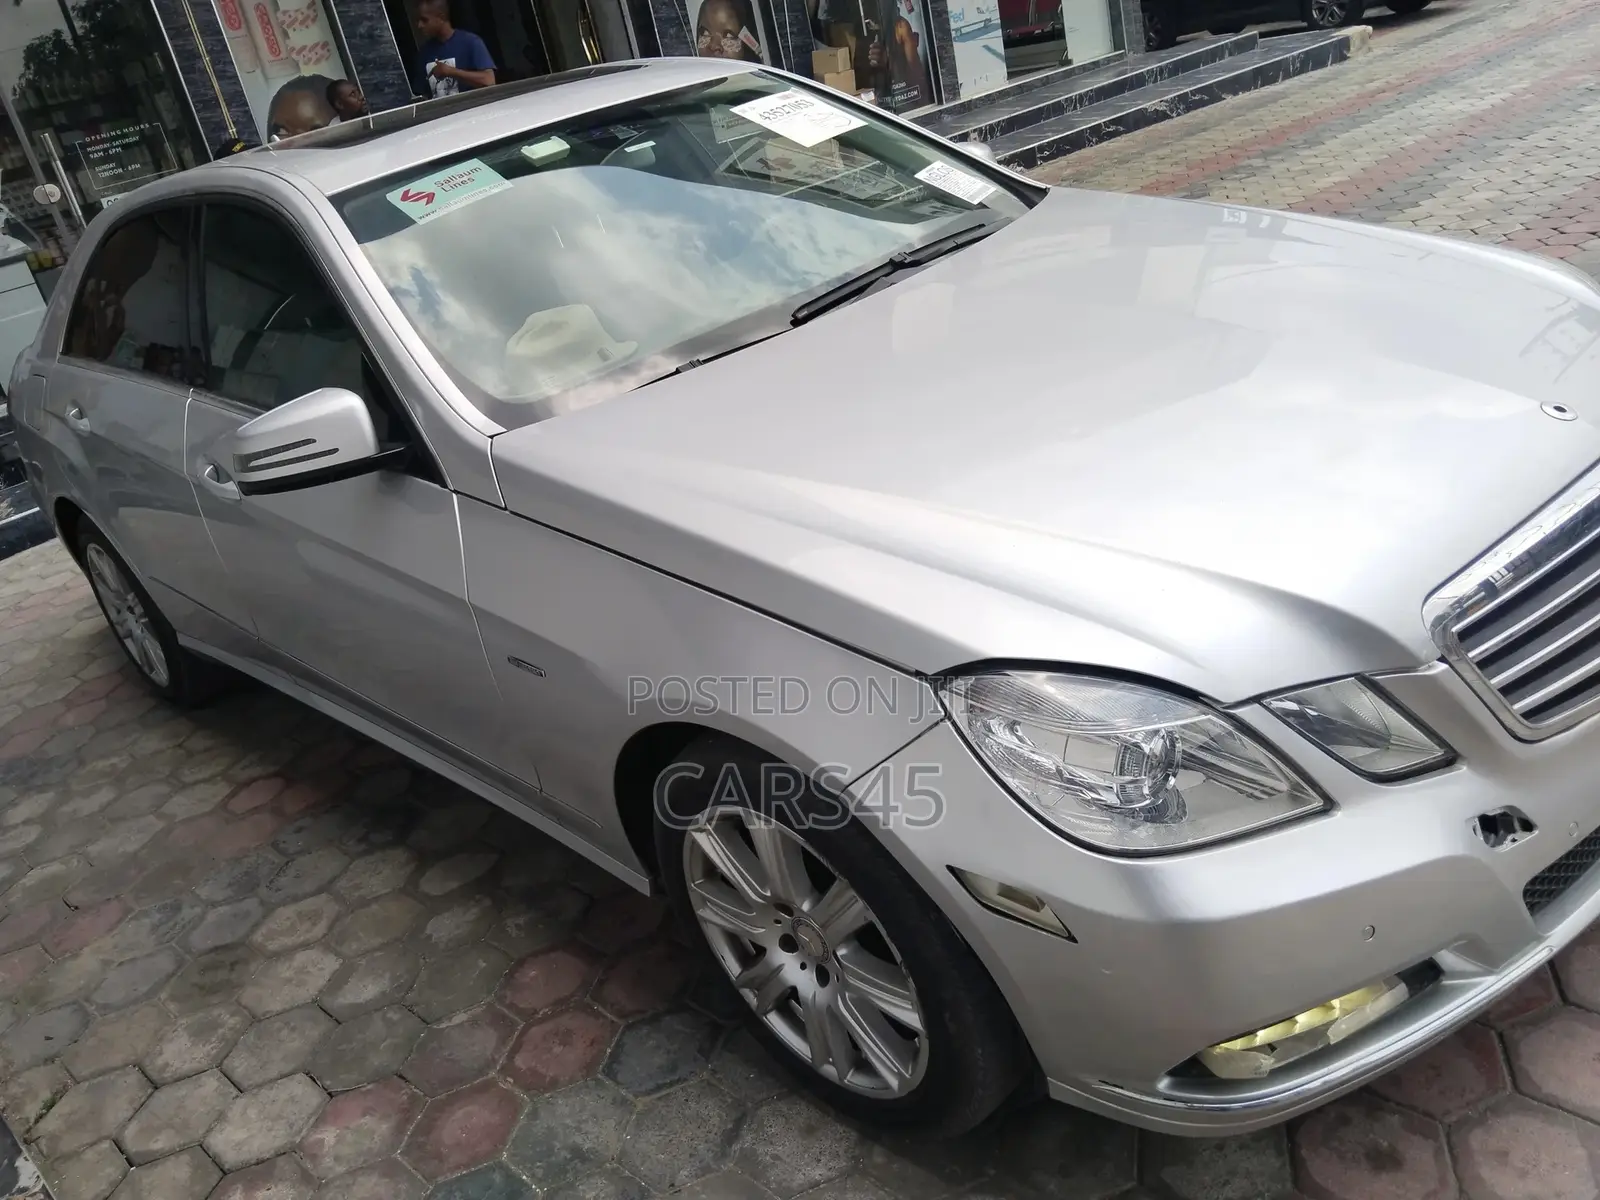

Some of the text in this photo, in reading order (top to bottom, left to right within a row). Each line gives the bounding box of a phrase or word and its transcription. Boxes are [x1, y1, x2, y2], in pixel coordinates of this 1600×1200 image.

[758, 98, 815, 121] 43527053
[85, 123, 150, 143] OPENING HOURS
[89, 151, 104, 159] 9AM
[109, 147, 122, 155] 6PM
[95, 162, 116, 172] SUNDAY
[98, 168, 123, 178] 12NOON
[128, 163, 141, 171] 6PM
[434, 166, 482, 188] Sallaum
[440, 177, 475, 193] Lines
